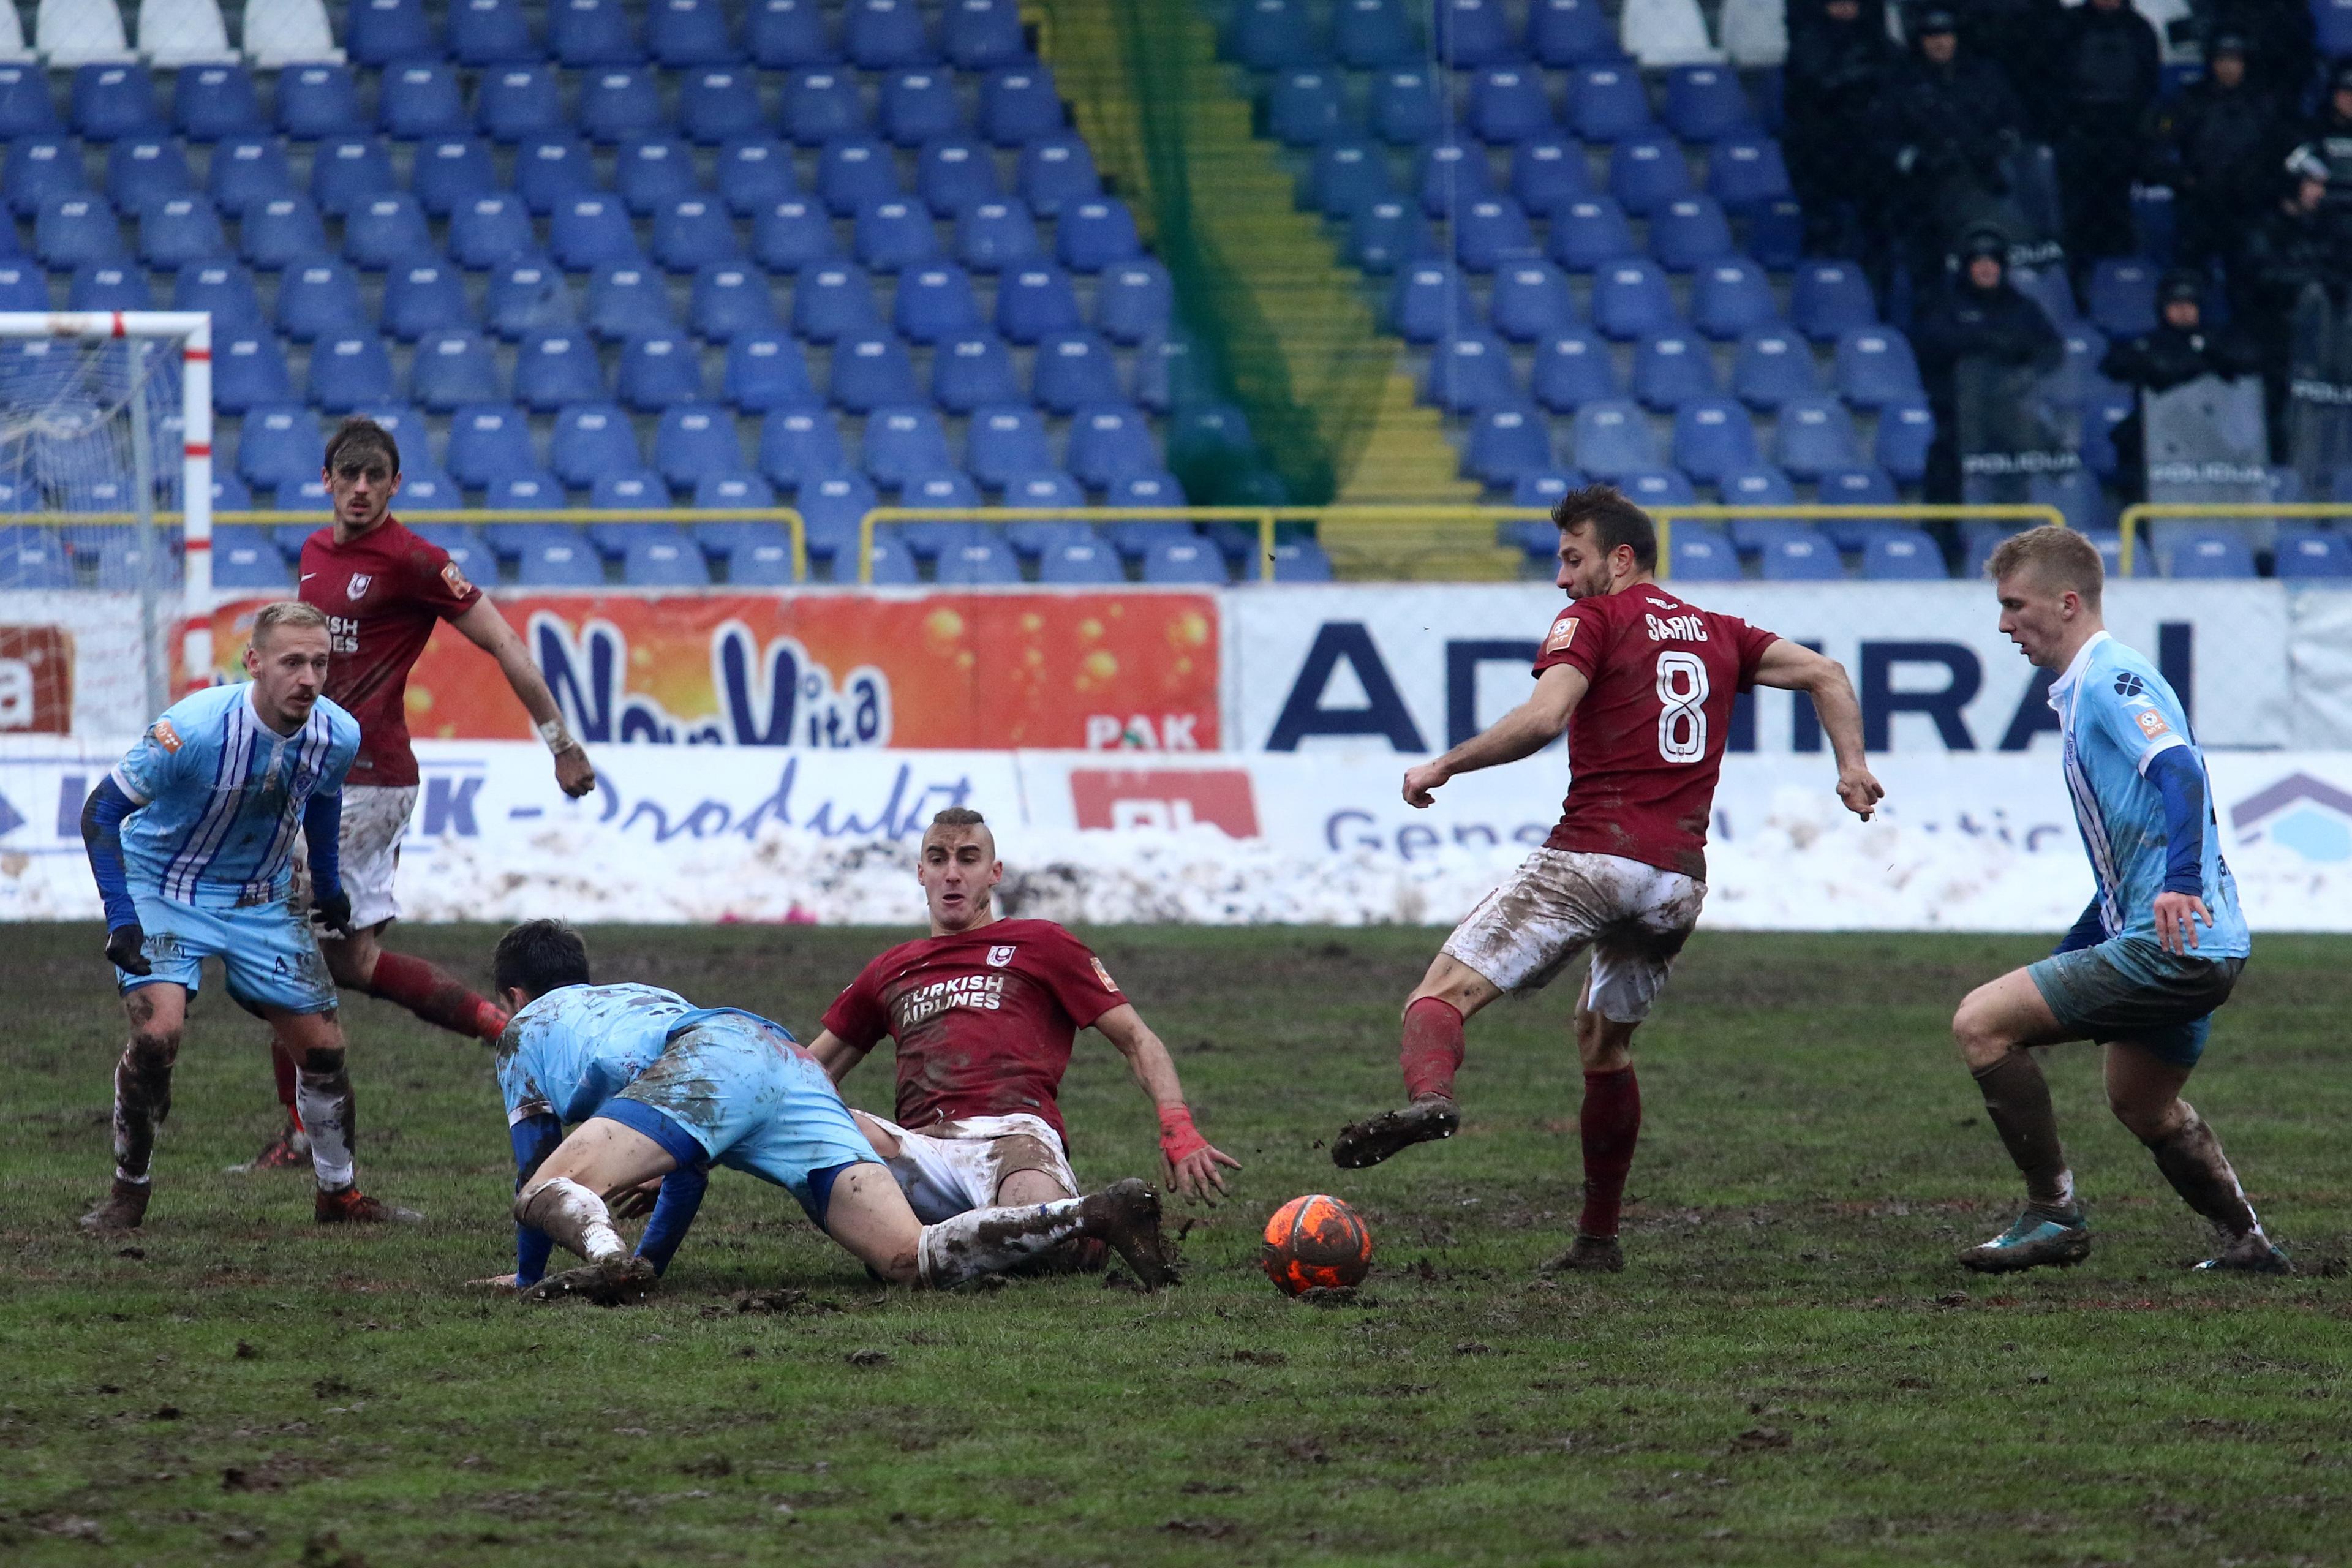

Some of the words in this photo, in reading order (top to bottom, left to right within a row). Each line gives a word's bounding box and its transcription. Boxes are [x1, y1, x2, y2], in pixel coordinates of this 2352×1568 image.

[326, 615, 358, 635] SH
[1645, 613, 1708, 642] SARIĆ
[1656, 650, 1709, 763] 8
[1086, 714, 1196, 750] PAK
[901, 975, 1005, 1010] TURKISH
[902, 992, 1001, 1028] AIRLINES
